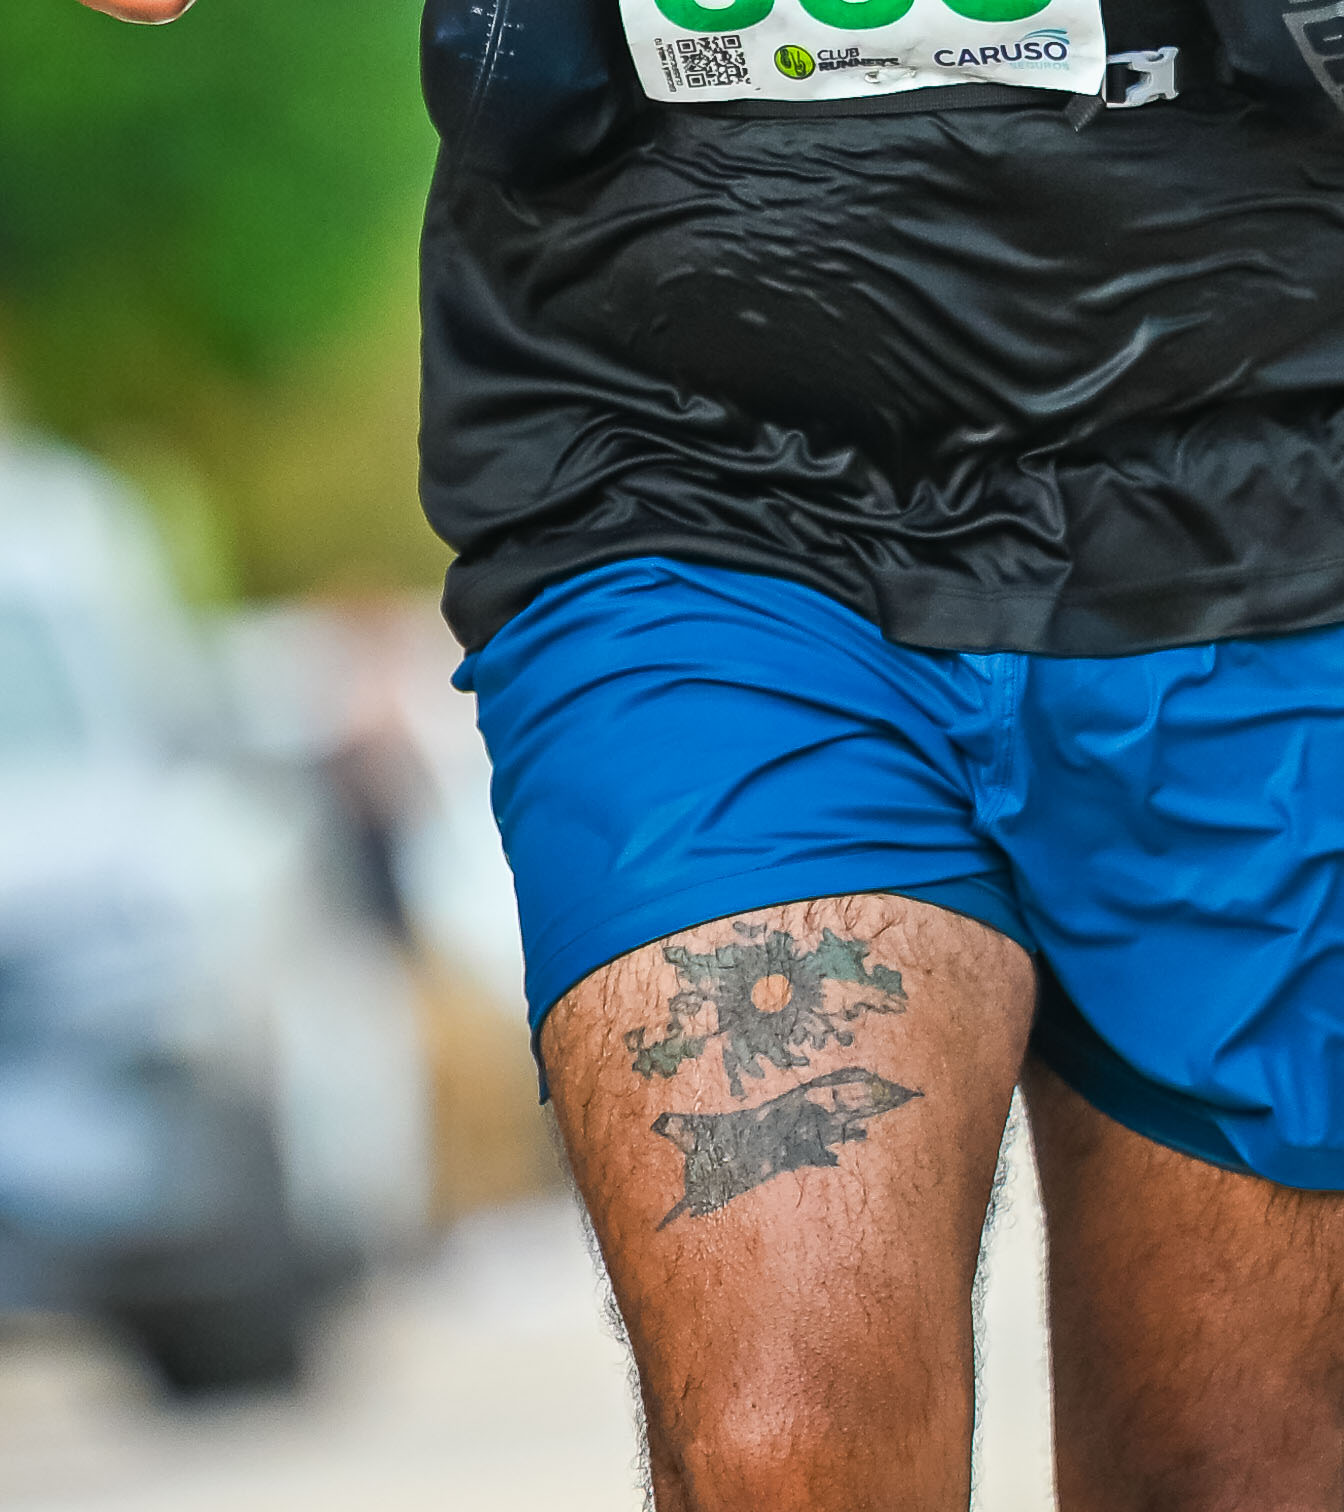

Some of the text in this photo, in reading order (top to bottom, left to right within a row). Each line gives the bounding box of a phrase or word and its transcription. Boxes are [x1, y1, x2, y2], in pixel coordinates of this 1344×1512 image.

[817, 47, 860, 61] CLUB
[933, 41, 1068, 67] CARUSO
[1009, 61, 1070, 71] SEGUROS
